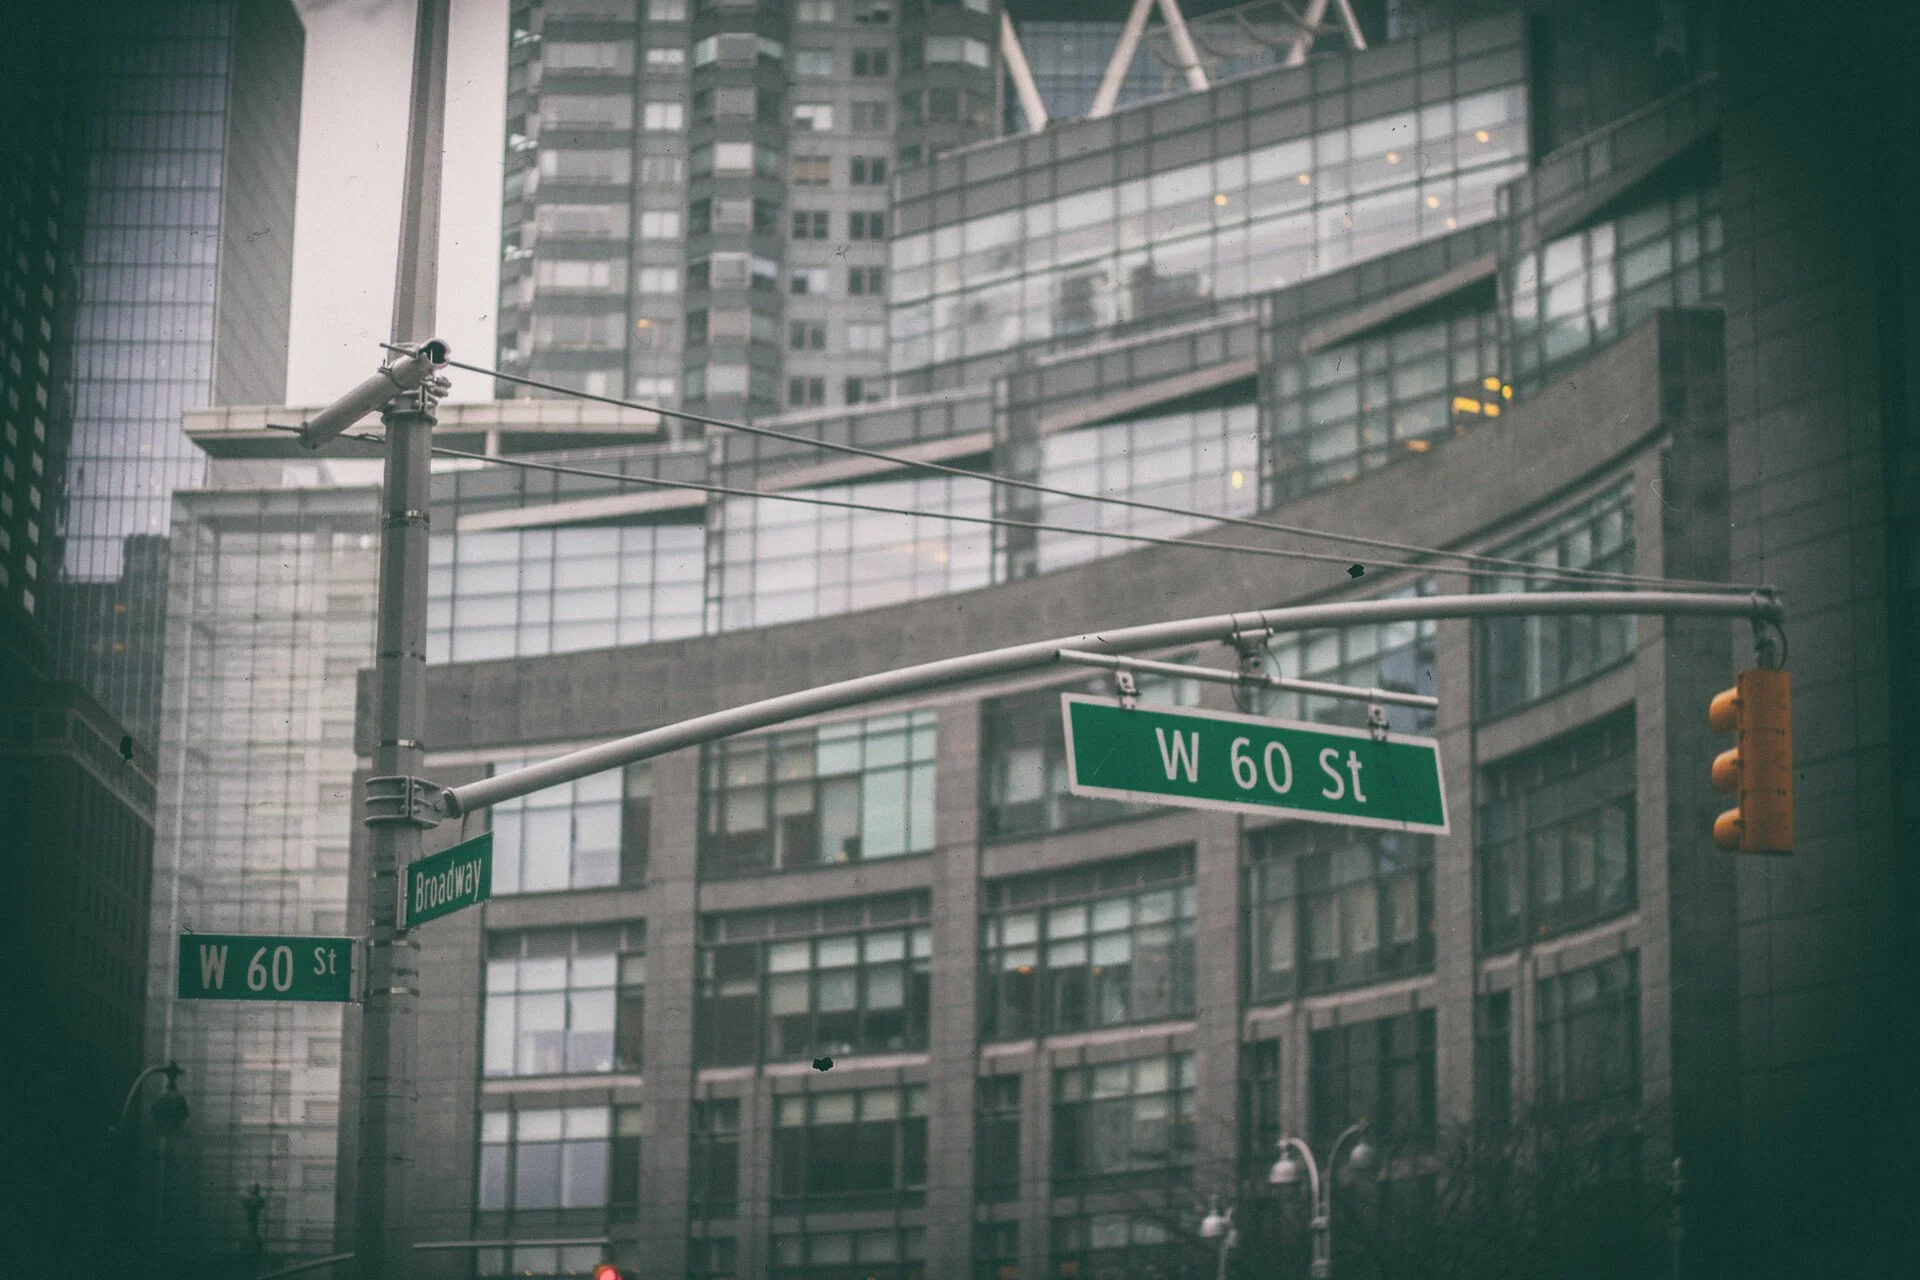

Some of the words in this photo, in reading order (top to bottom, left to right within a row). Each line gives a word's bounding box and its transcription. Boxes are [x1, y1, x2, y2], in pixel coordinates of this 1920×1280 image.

[1155, 727, 1199, 783] W
[1230, 737, 1293, 794] 60
[1318, 748, 1367, 803] St
[415, 858, 482, 914] Broadway
[200, 944, 228, 990] W
[247, 945, 294, 992] 60
[313, 946, 337, 976] St
